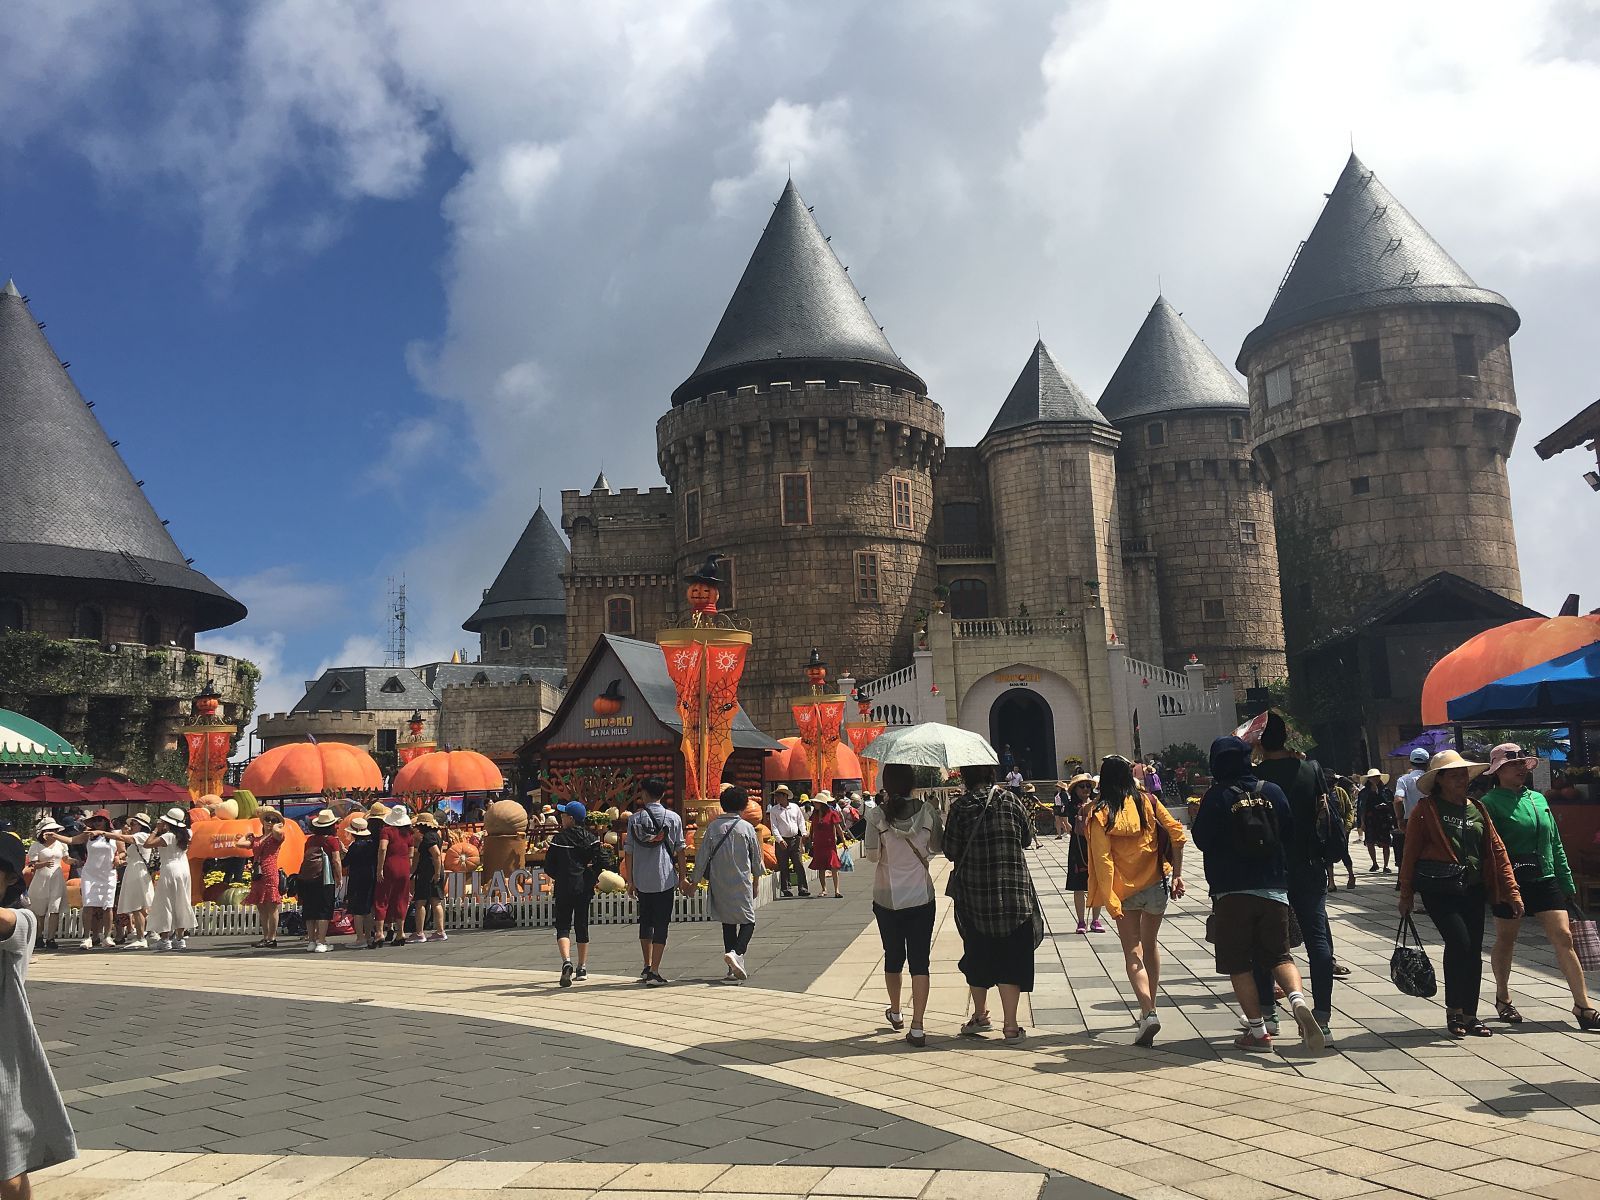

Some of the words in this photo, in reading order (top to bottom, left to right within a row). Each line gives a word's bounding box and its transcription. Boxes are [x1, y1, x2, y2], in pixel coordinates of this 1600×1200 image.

[611, 728, 628, 736] HILLS
[1443, 815, 1474, 827] CLOTHNG
[444, 868, 547, 899] ILLAGE
